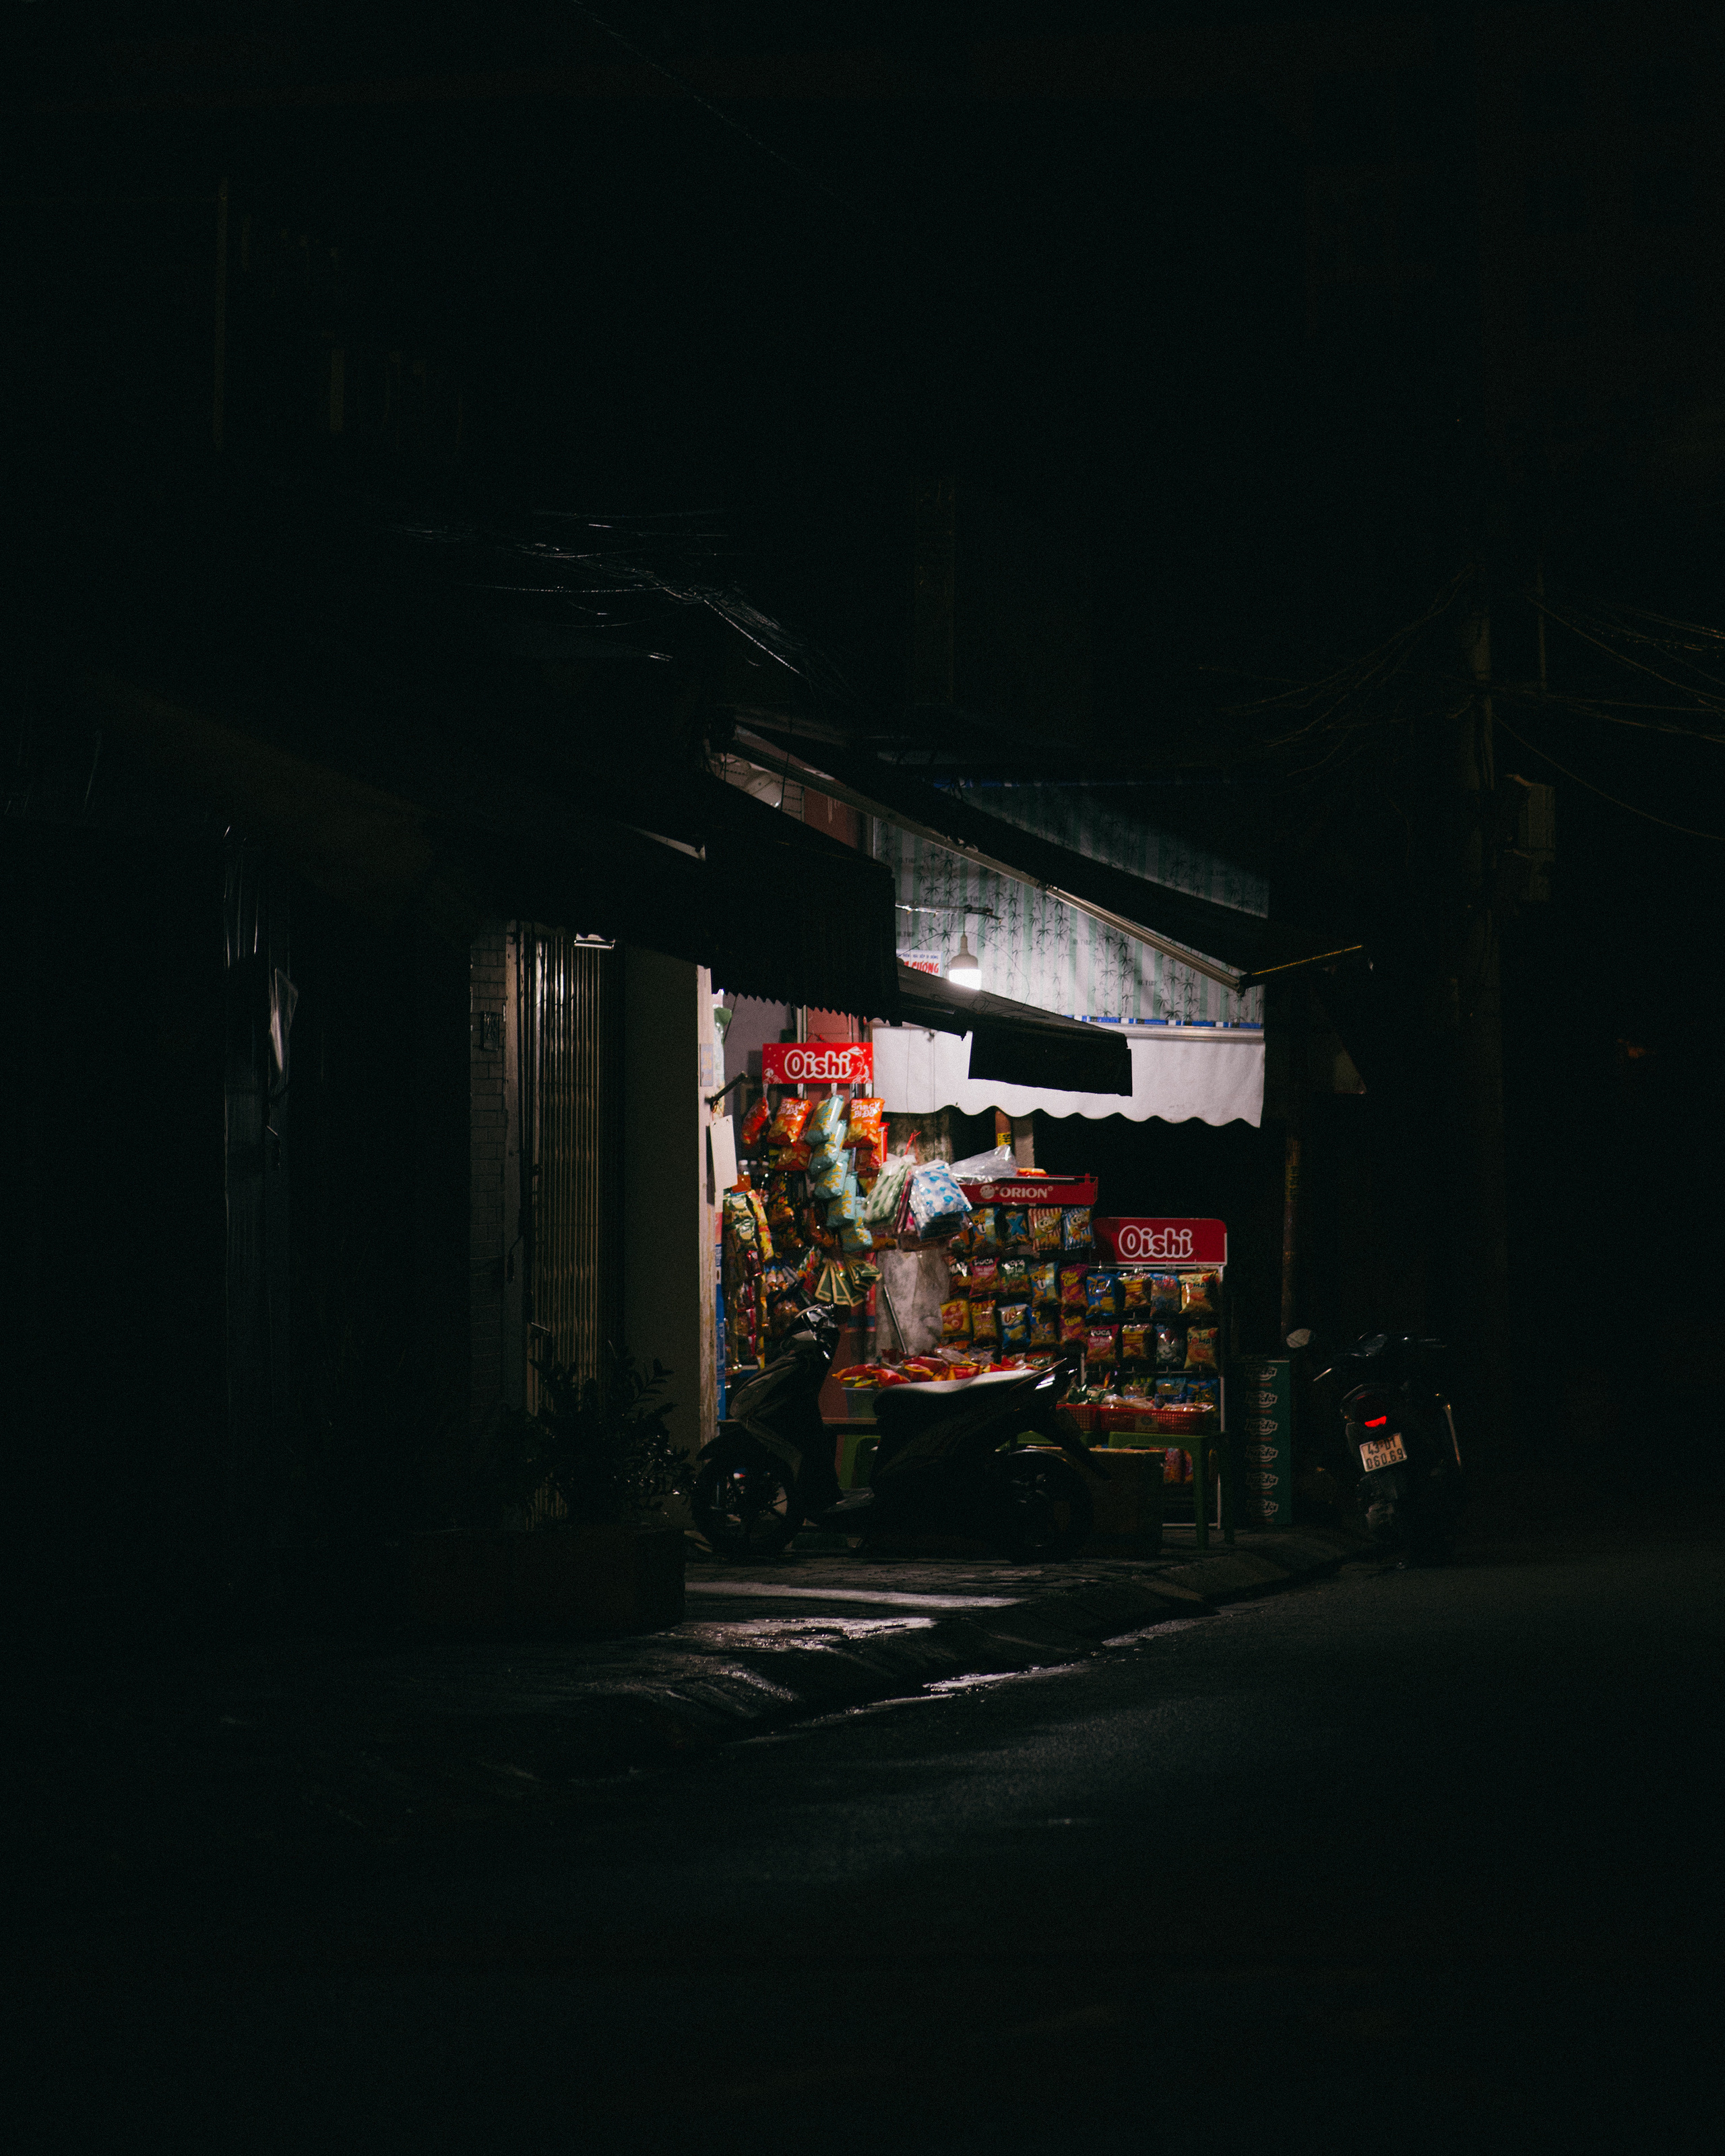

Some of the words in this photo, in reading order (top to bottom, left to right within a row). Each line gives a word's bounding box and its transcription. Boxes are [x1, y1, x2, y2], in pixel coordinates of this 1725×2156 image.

[784, 1049, 851, 1079] Oishi
[999, 1186, 1048, 1198] ORION
[1119, 1225, 1193, 1258] Oishi
[1366, 1448, 1404, 1469] 060.69
